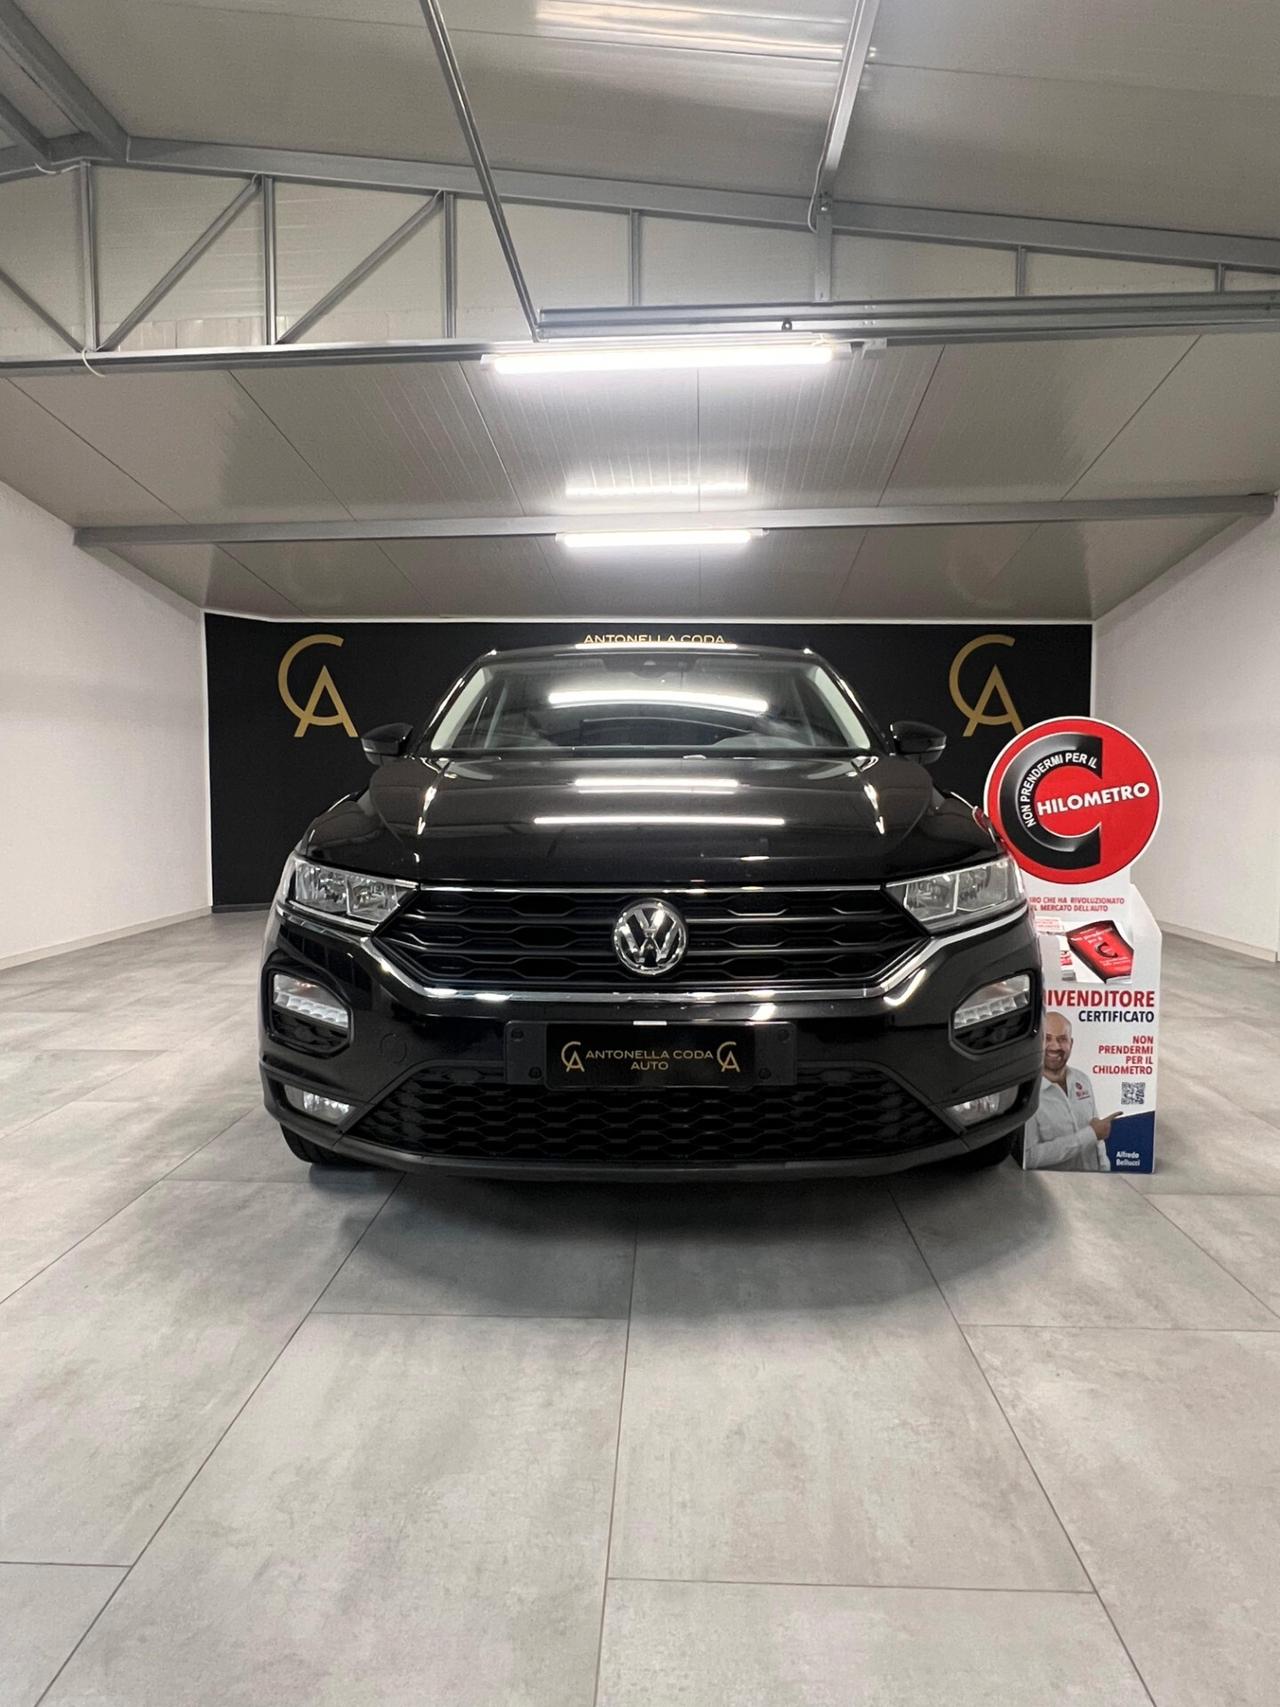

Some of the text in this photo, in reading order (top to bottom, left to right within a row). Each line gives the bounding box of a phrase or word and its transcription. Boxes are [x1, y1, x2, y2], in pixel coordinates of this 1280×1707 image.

[1020, 752, 1098, 828] NON PRENDERMI PER IL
[1043, 990, 1155, 1007] IVENDITORE
[1078, 1010, 1155, 1023] CERTIFICATO
[1132, 1035, 1154, 1045] NON
[586, 1050, 714, 1060] ANTONELLA CODA
[1098, 1045, 1153, 1055] PRENDERMI
[1125, 1055, 1154, 1065] PER IL
[630, 1061, 669, 1071] AUTO
[1092, 1065, 1153, 1075] CHILOMETRO
